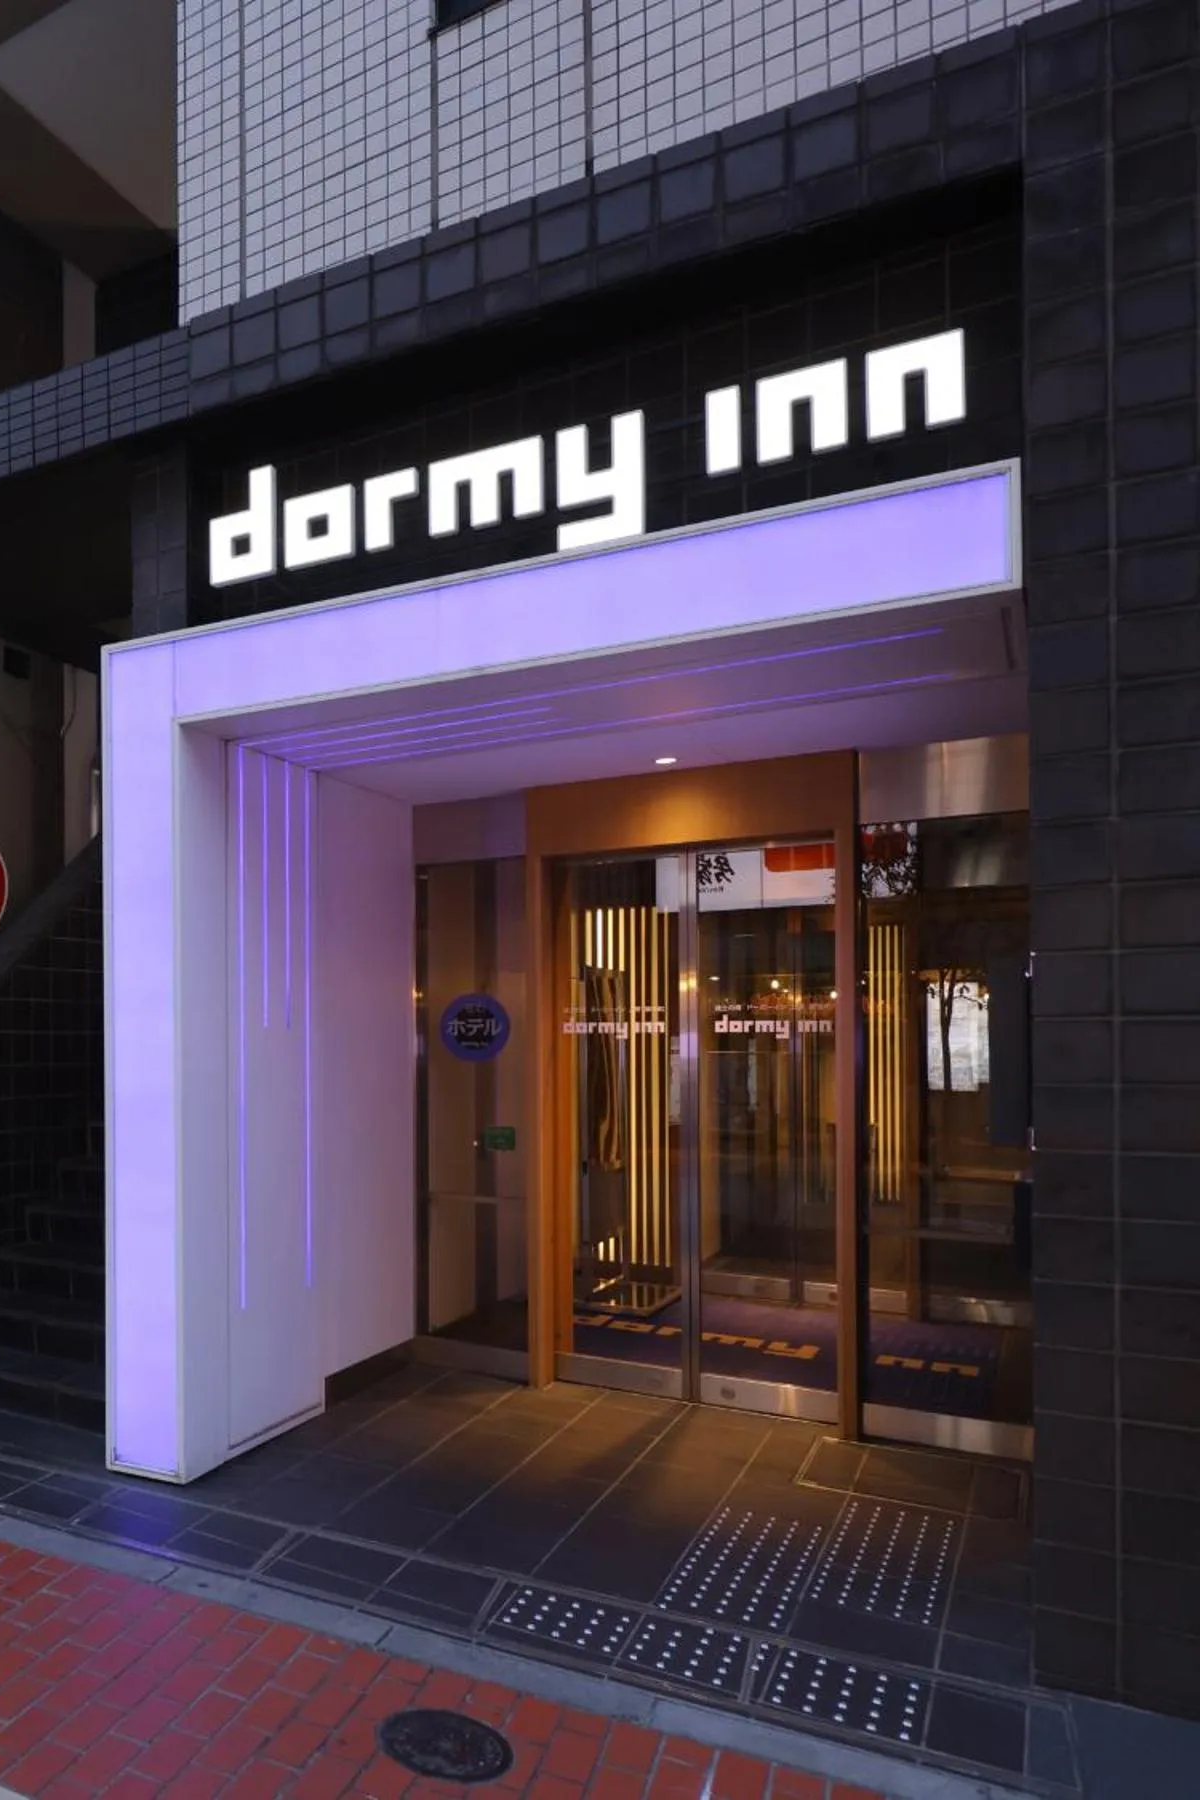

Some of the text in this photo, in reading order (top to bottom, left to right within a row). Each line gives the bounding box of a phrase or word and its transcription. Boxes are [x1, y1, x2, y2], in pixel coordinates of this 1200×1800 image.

[208, 327, 967, 588] dormy inn
[445, 1018, 504, 1037] ホテル
[562, 1017, 629, 1040] dormy
[714, 1014, 834, 1040] dormy inn
